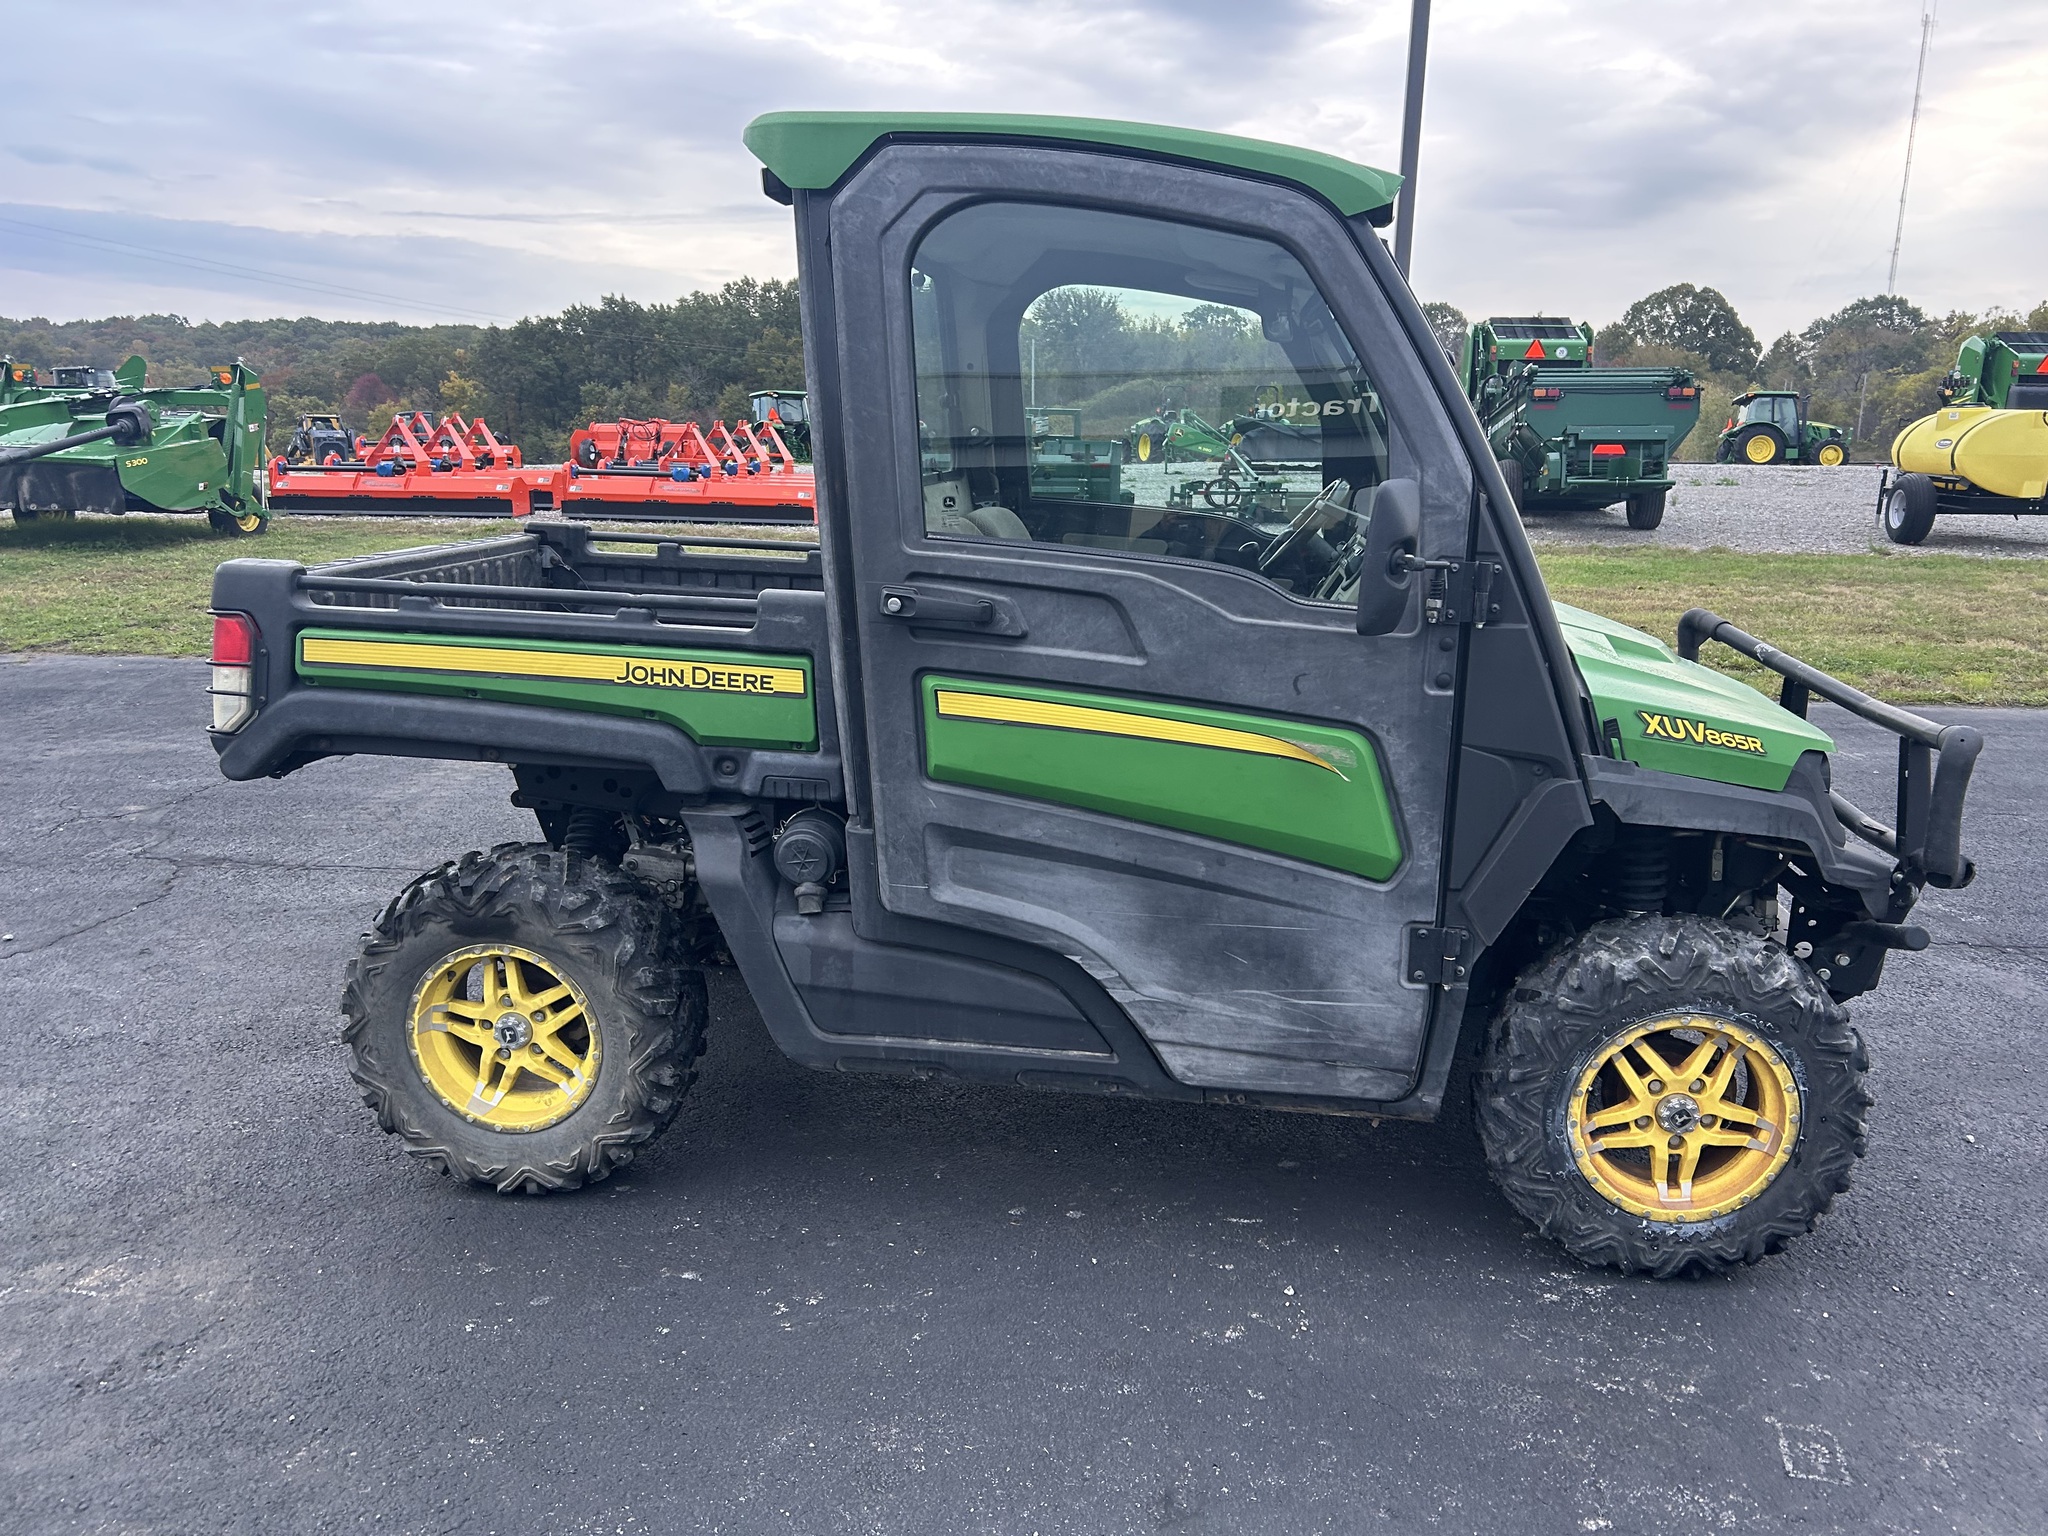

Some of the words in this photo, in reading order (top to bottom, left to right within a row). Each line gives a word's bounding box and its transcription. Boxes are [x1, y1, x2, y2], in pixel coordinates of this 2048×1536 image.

[616, 661, 685, 685] JOHN
[691, 666, 774, 691] DEERE
[1639, 711, 1767, 754] XUV865R
